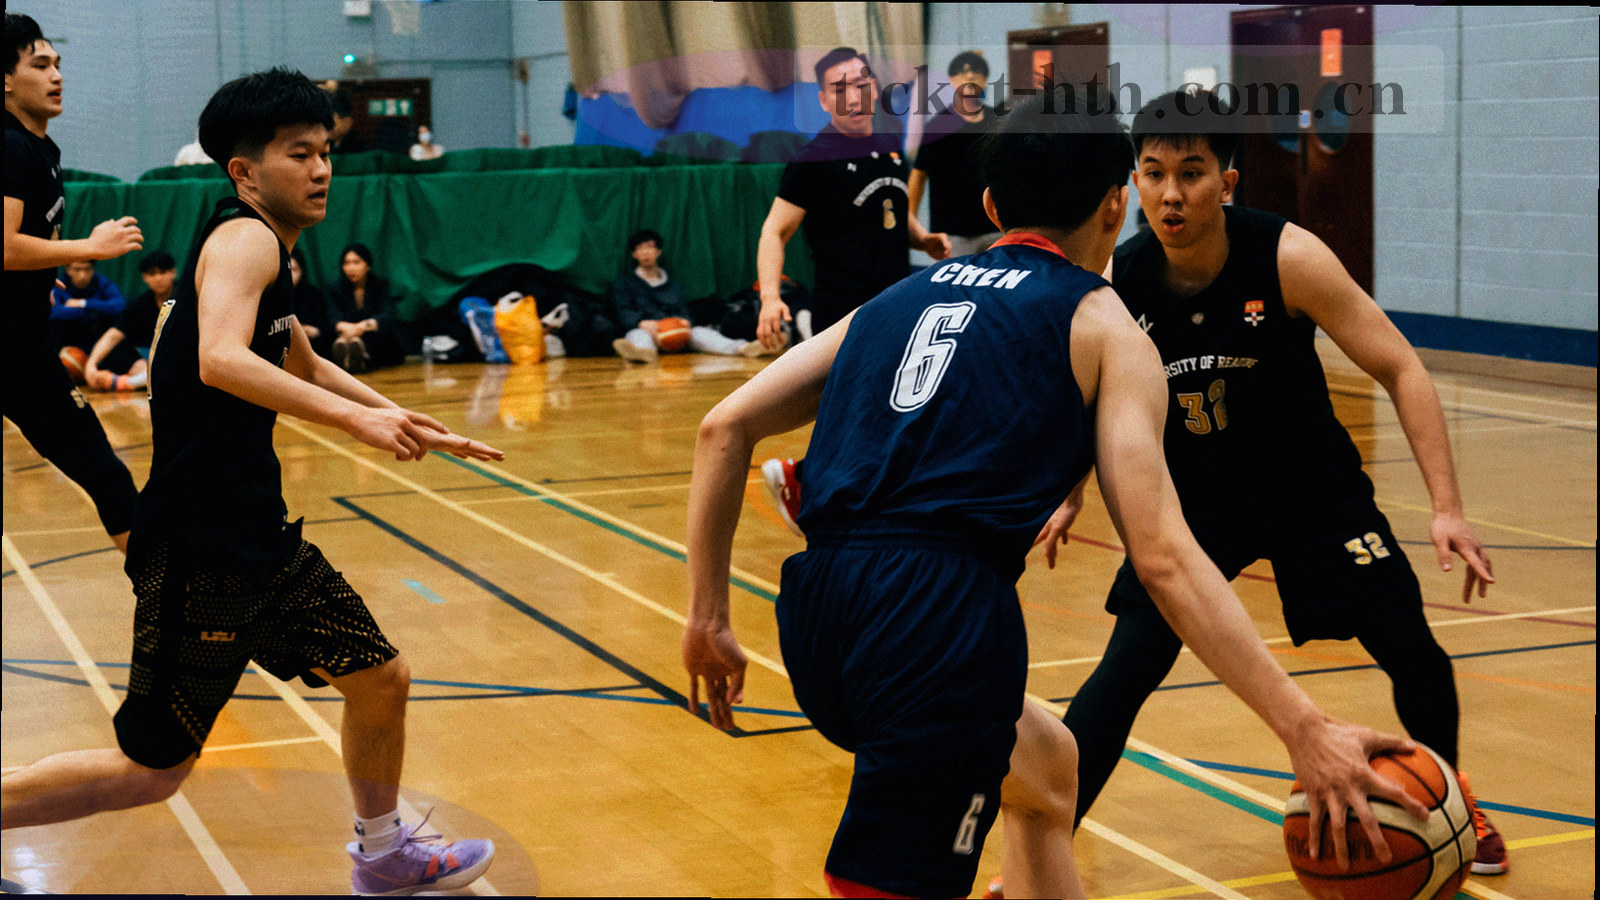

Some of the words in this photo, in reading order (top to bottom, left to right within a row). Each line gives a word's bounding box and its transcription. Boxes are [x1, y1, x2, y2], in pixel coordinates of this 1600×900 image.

[931, 262, 1033, 289] CHEN
[889, 301, 977, 413] 6
[1200, 355, 1215, 370] OF
[1344, 532, 1391, 565] 32
[952, 793, 985, 855] 6
